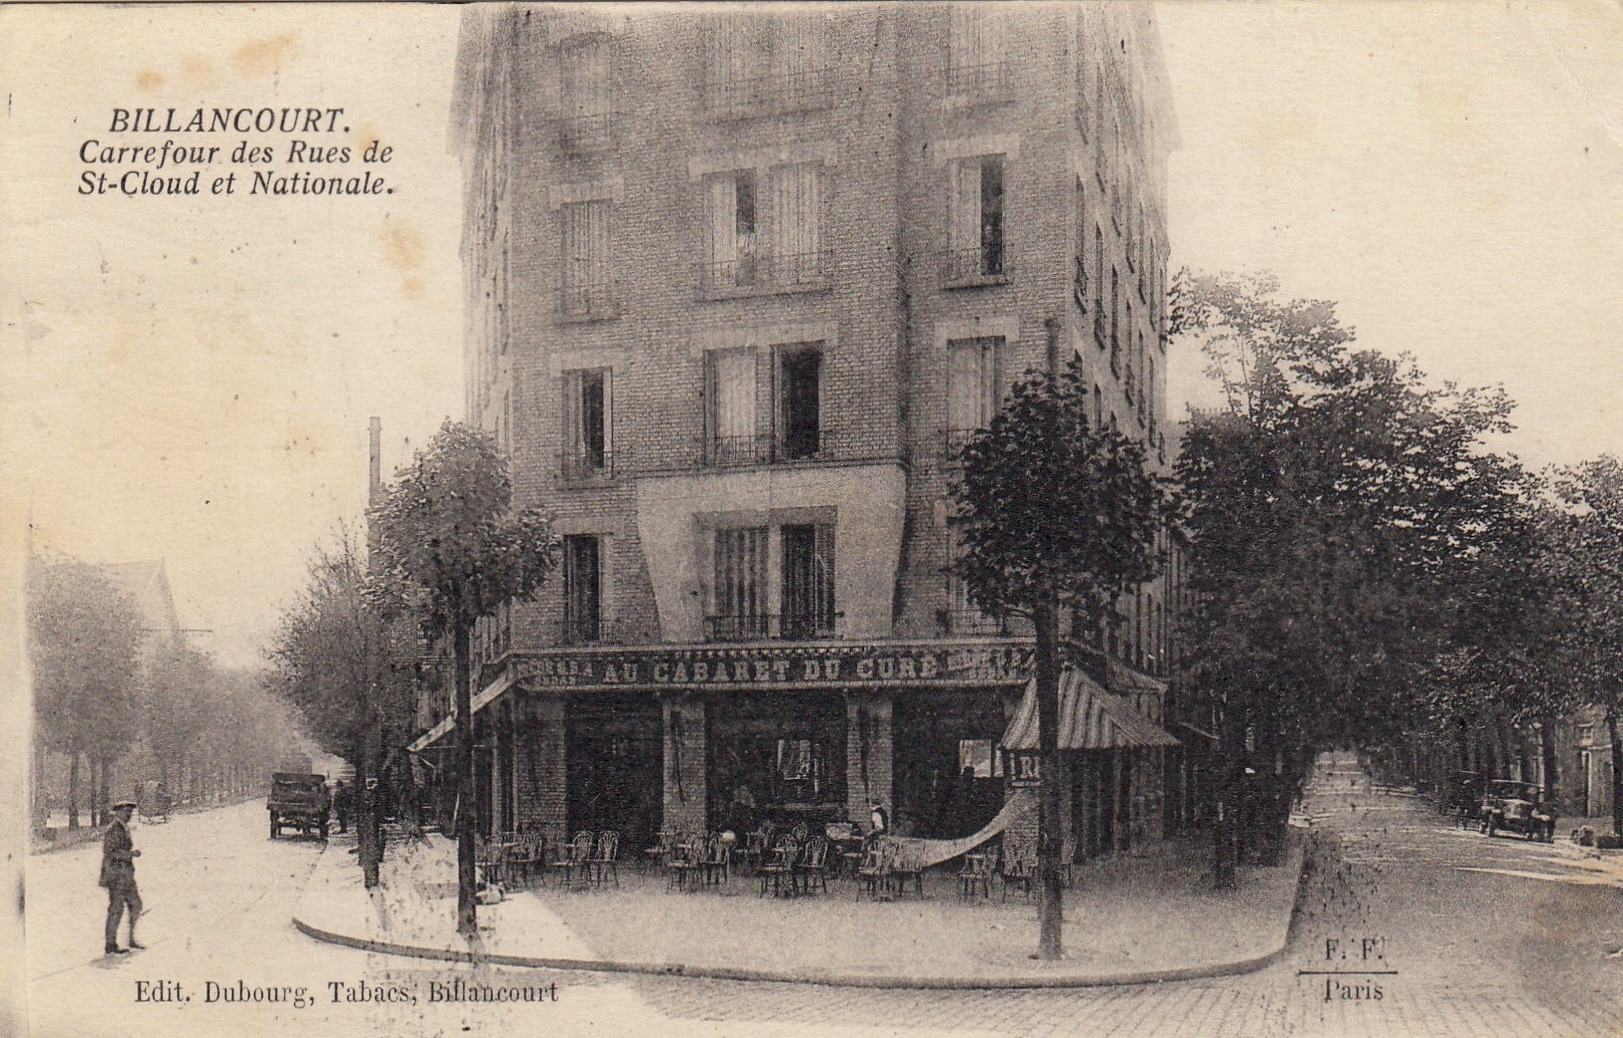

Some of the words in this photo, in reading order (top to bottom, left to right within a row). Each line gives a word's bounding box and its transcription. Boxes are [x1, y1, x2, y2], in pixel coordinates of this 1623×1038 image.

[603, 661, 638, 683] AU
[654, 660, 790, 682] CABARET
[803, 658, 841, 681] DU
